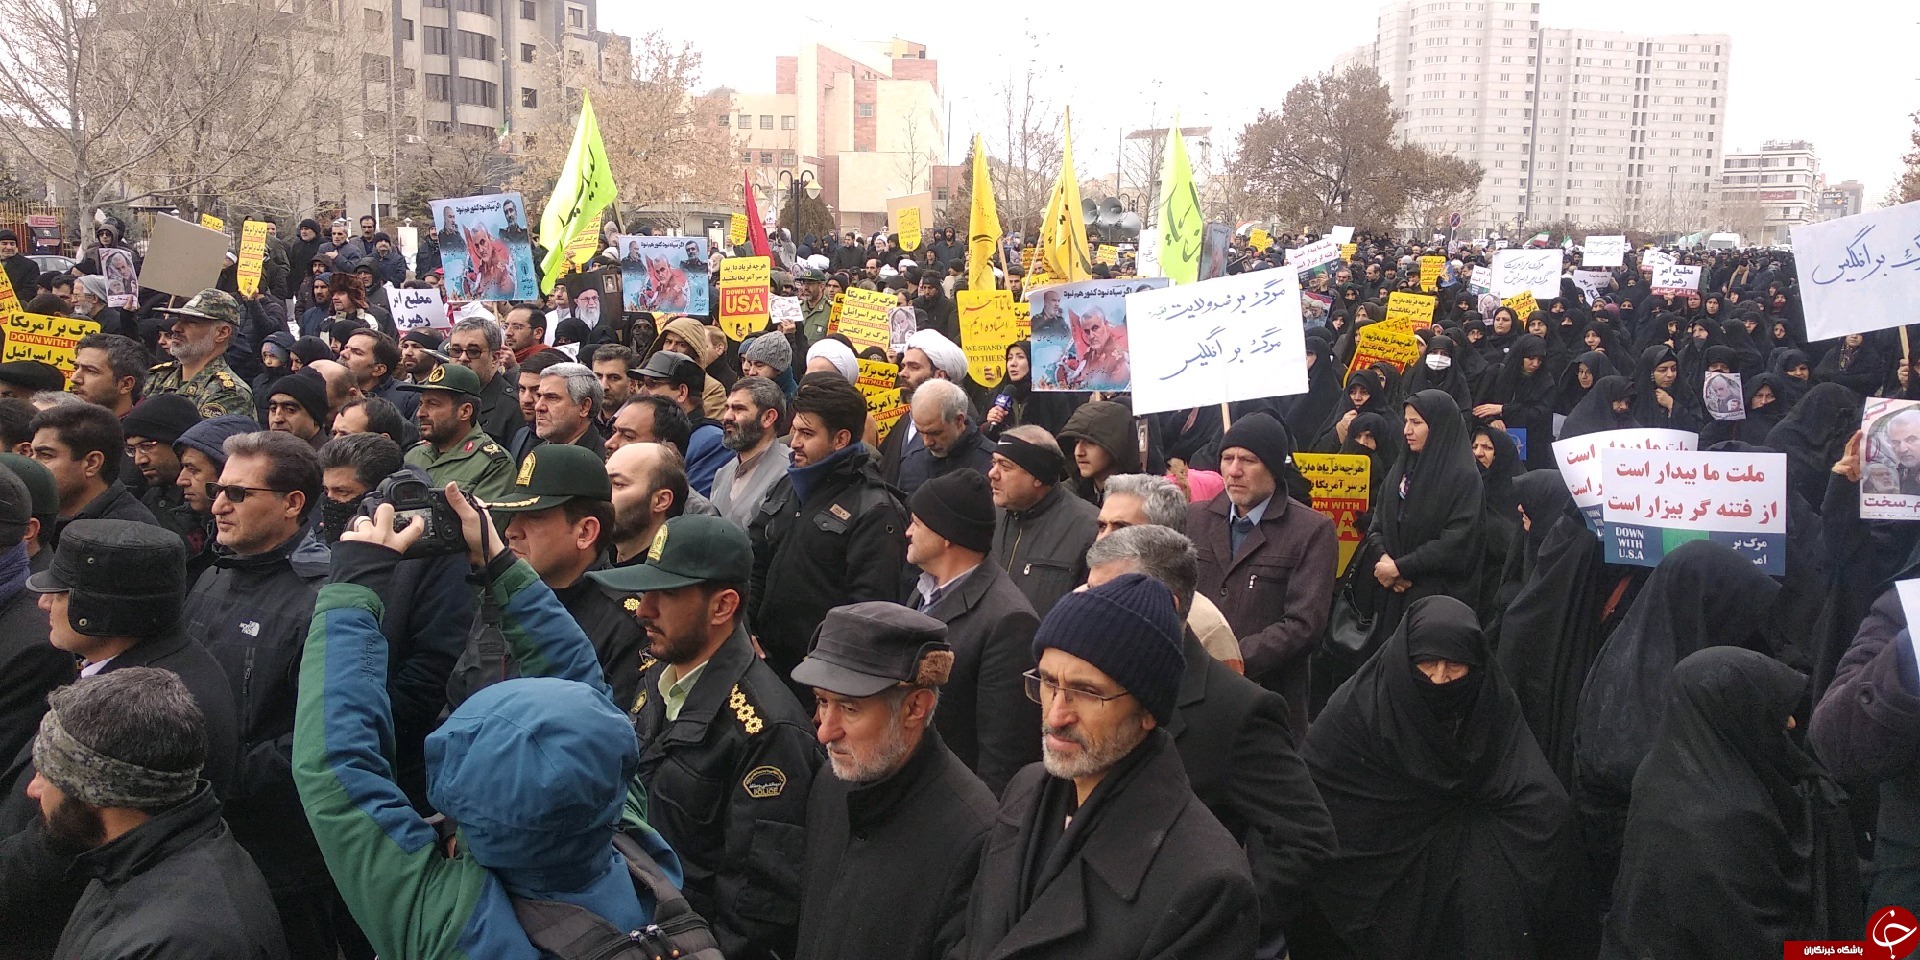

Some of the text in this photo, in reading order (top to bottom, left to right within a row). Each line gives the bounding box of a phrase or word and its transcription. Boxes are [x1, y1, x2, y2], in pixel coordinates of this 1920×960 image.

[1812, 224, 1887, 285] بر انگلیس
[1660, 266, 1693, 276] مطیع امر
[1662, 279, 1687, 287] رهبریم
[847, 290, 896, 306] مرگ بر آمریکا
[1064, 290, 1074, 299] نبود
[1084, 288, 1096, 299] کشور
[1098, 290, 1110, 298] نبود
[1110, 289, 1122, 297] سپاه
[1123, 287, 1132, 297] اگر
[1250, 278, 1285, 307] مرگ
[1520, 292, 1532, 301] مرگ
[405, 291, 432, 309] مطیع
[726, 294, 763, 313] USA
[1231, 294, 1245, 313] بر
[843, 307, 869, 318] اسرائیل
[10, 314, 54, 334] آمریکا
[53, 324, 66, 337] بر
[10, 332, 42, 344] DOWN
[44, 336, 68, 347] WITH
[6, 346, 52, 361] اسرائیل
[1159, 326, 1282, 380] مرگ بر انگلیس
[52, 354, 64, 366] بر
[878, 368, 896, 378] مرگ
[867, 396, 891, 412] آمریک
[1566, 444, 1595, 465] است
[1298, 464, 1315, 474] داری
[1317, 464, 1338, 474] فریاد
[1616, 460, 1765, 485] ملت ما بیدار است
[1316, 480, 1367, 492] بر سر آمریکا
[1571, 477, 1592, 495] است
[1608, 494, 1778, 525] از فتنه گر بیزار است
[1615, 527, 1644, 539] DOWN
[1618, 537, 1643, 549] WITH
[1732, 539, 1742, 550] بر
[1619, 549, 1644, 560] U.S.A
[754, 788, 778, 796] POLICE
